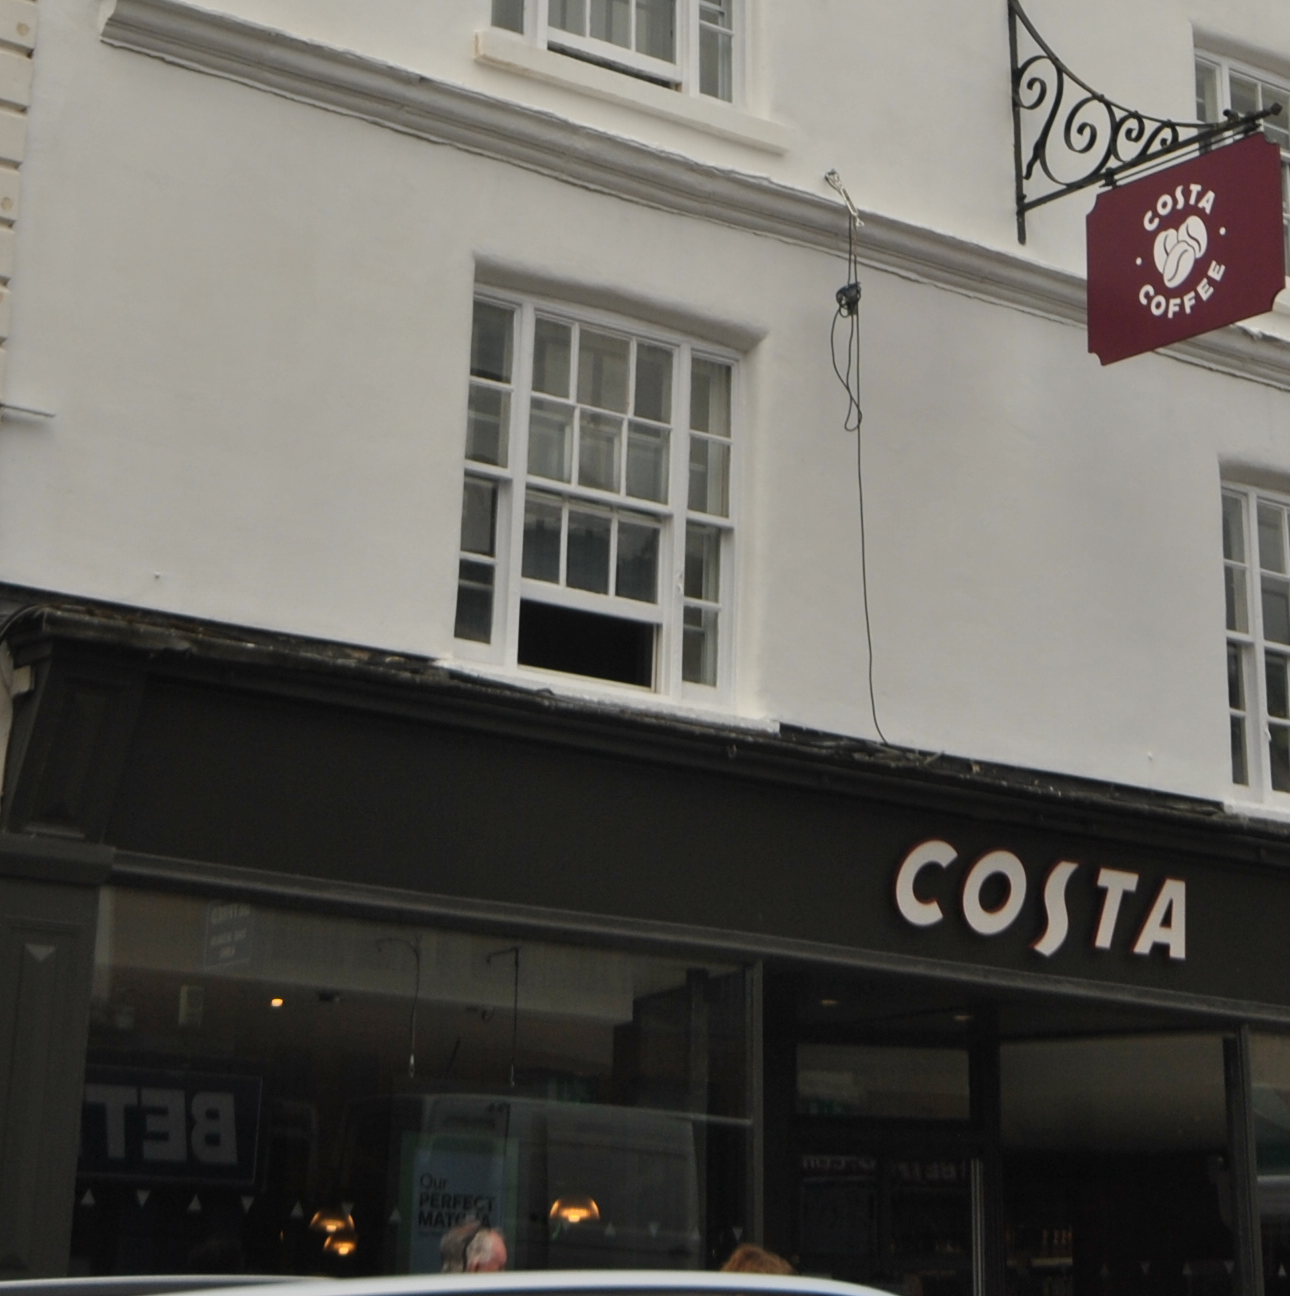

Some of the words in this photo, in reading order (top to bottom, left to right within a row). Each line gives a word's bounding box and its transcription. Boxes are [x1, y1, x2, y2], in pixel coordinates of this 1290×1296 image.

[1143, 183, 1216, 232] COSTA
[1139, 259, 1225, 319] COFFEE
[895, 839, 1186, 960] COSTA
[420, 1172, 448, 1190] Our
[418, 1209, 491, 1228] MATCA
[419, 1192, 497, 1212] PERFECT
